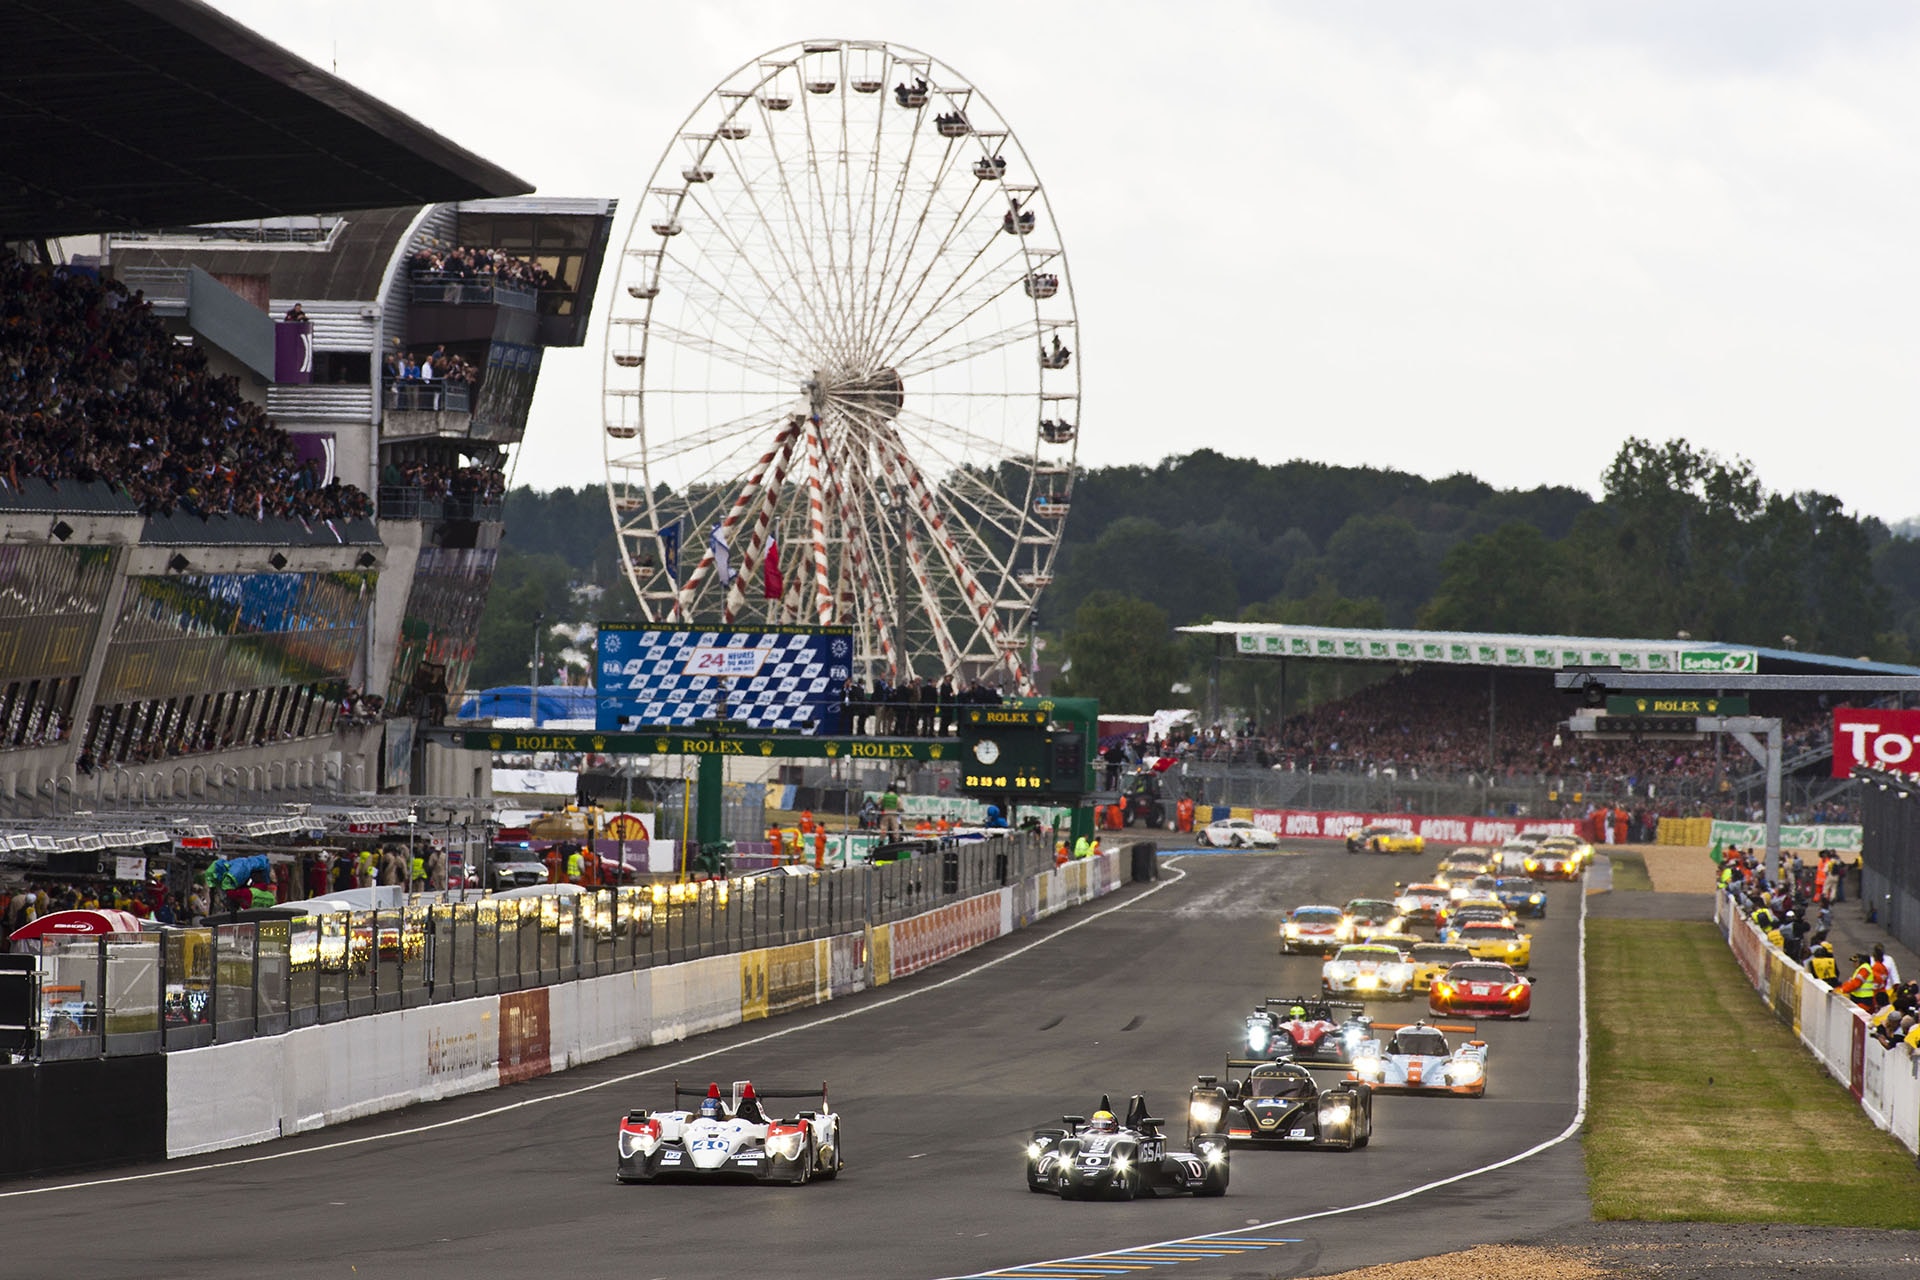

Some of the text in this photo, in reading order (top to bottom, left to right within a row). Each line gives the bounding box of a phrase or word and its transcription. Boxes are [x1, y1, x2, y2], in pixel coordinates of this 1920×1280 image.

[698, 654, 725, 668] 24
[1684, 657, 1720, 669] Sarthe
[1654, 701, 1700, 712] ROLEX
[986, 712, 1028, 722] ROLEX
[516, 736, 576, 750] ROLEX
[682, 740, 744, 754] ROLEX
[852, 744, 914, 757] ROLEX
[1420, 820, 1468, 842] MOTUL
[692, 1140, 729, 1152] 40
[1038, 1156, 1051, 1174] 0
[1085, 1157, 1102, 1166] 0
[1188, 1160, 1201, 1178] 0
